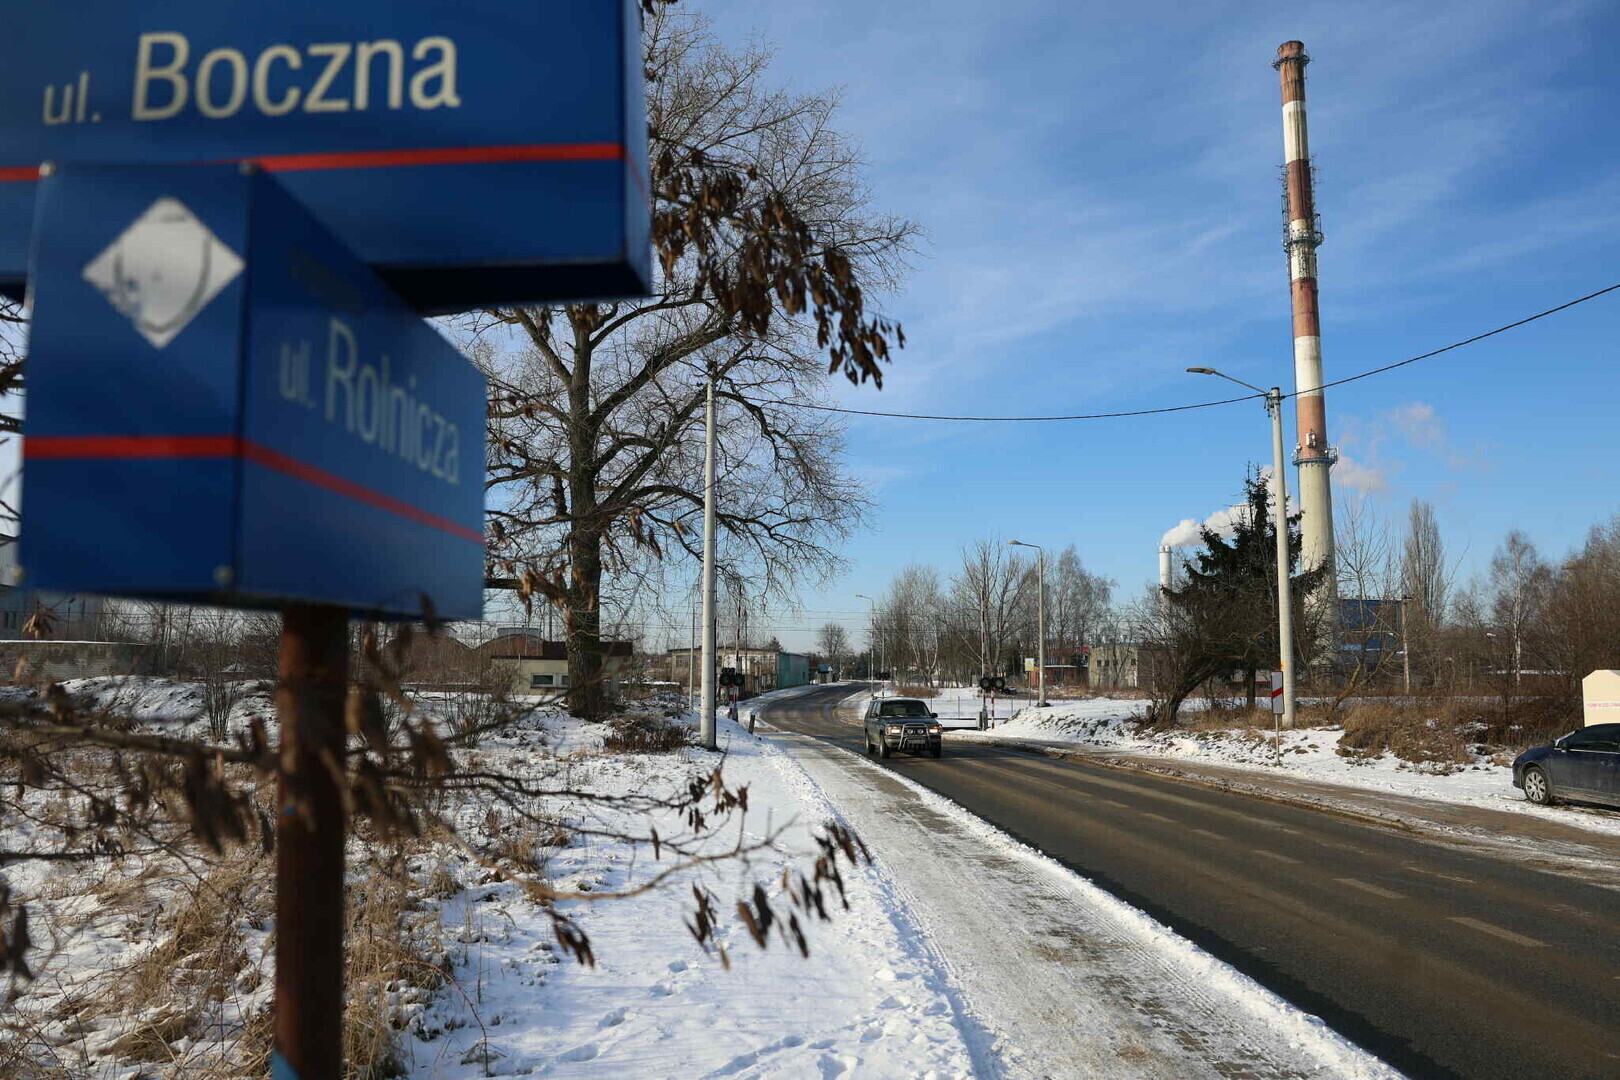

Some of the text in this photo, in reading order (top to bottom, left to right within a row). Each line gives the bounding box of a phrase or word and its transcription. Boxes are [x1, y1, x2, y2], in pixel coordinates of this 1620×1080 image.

[43, 32, 461, 125] ul. Boczna
[279, 316, 460, 485] ul. Rolnicza
